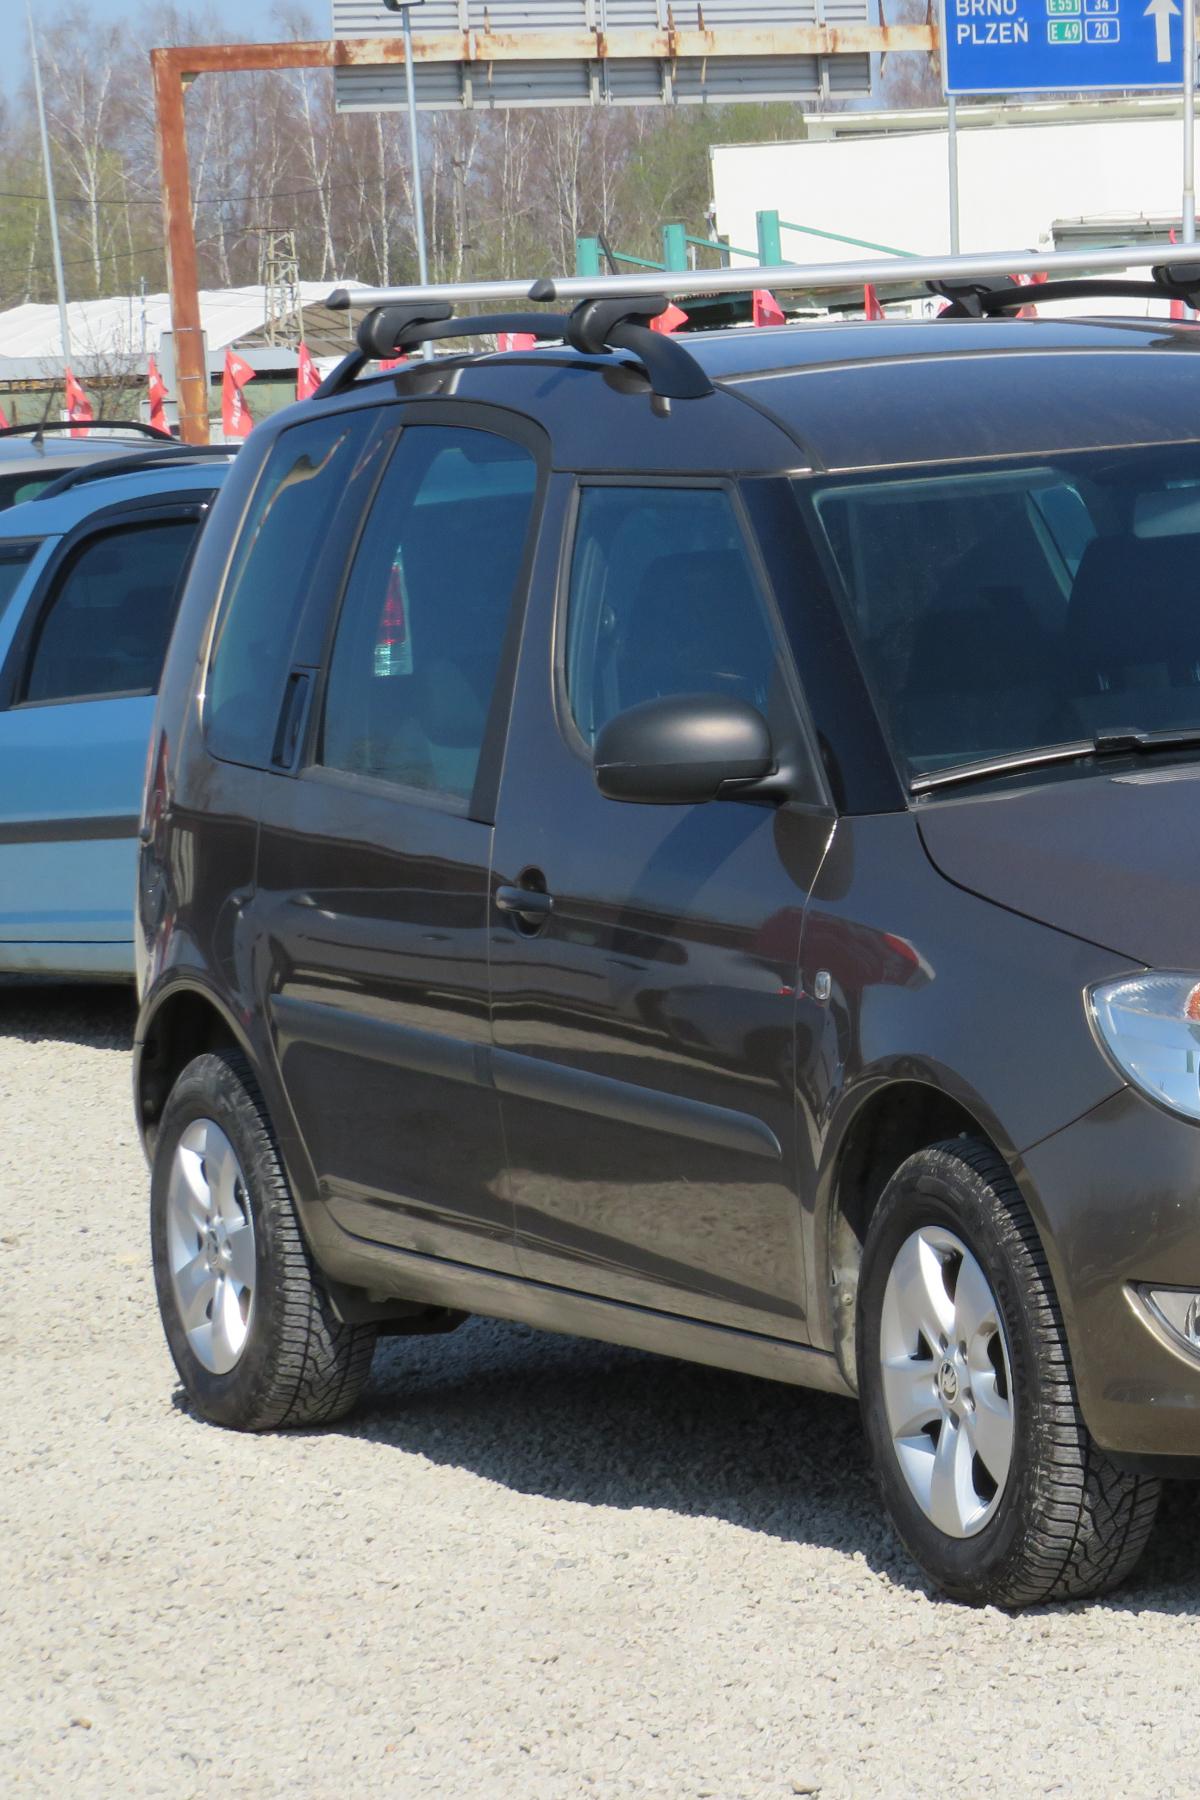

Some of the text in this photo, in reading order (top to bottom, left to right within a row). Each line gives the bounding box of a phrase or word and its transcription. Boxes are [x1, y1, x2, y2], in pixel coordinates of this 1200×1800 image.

[956, 0, 1017, 16] BRNO
[957, 17, 1028, 45] PLZEŇ
[1094, 22, 1109, 38] 20
